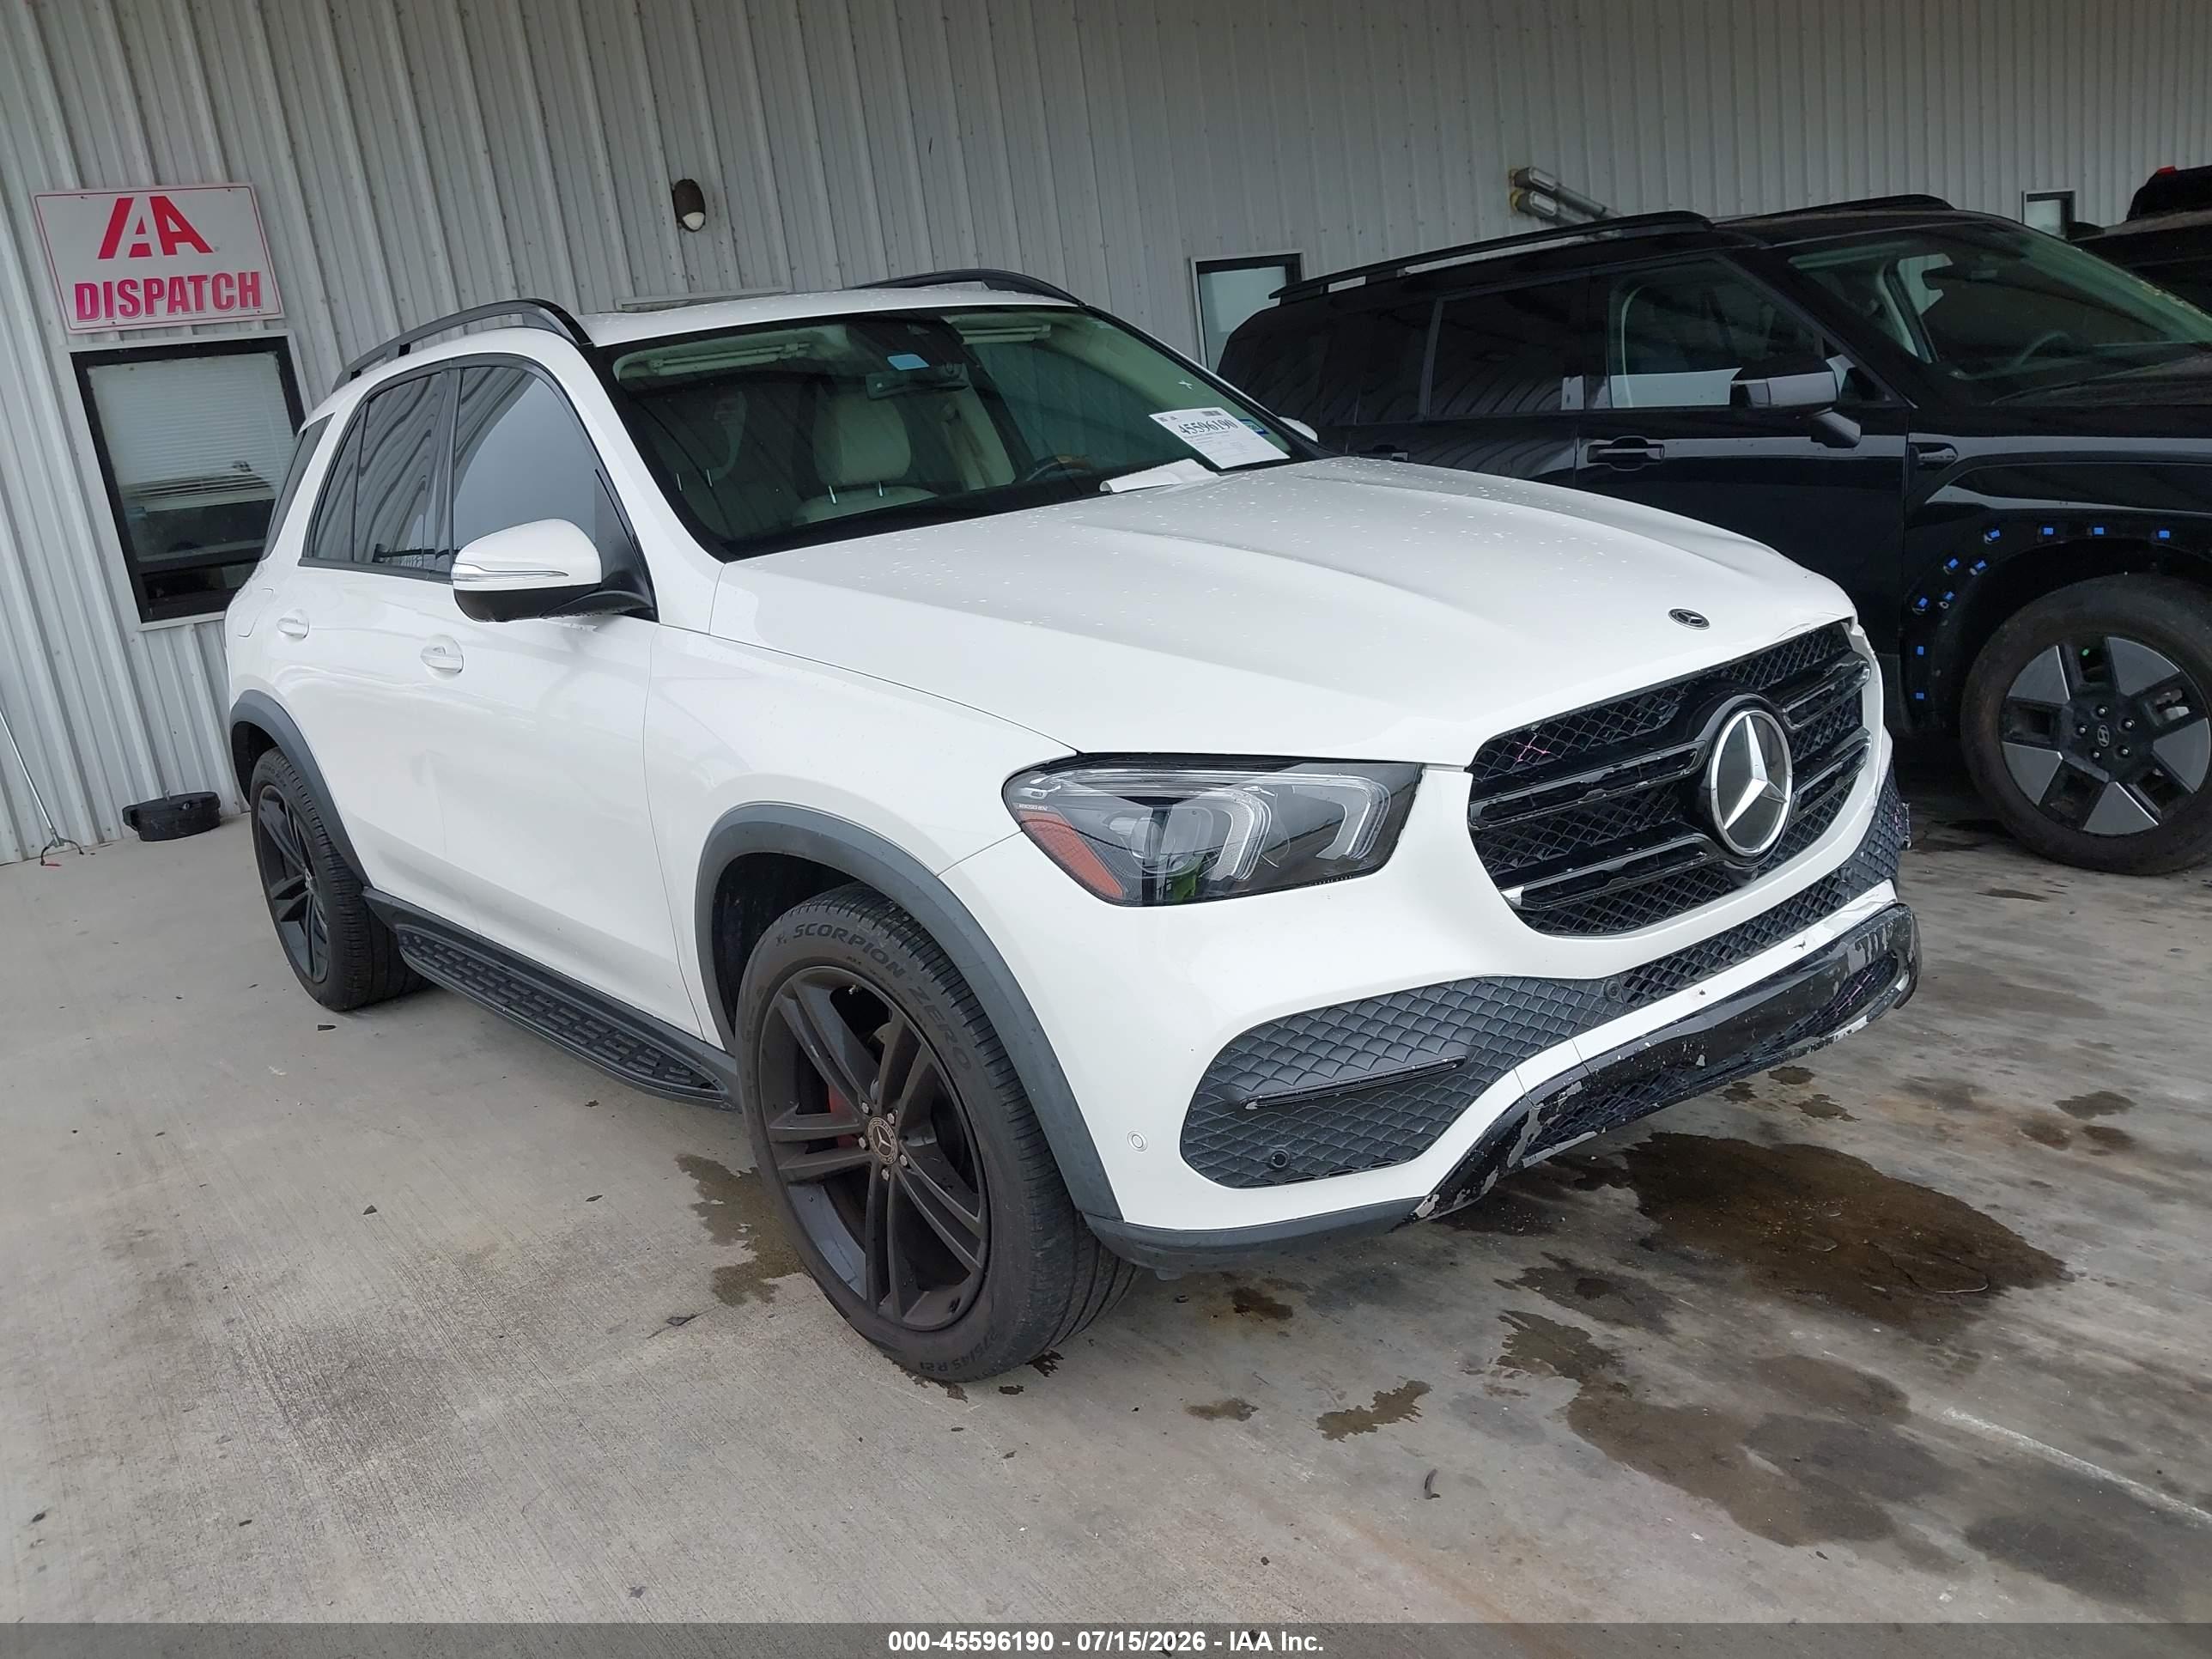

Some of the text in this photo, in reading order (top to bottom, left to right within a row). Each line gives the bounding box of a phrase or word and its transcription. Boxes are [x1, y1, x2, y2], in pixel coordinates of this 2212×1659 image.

[75, 271, 261, 322] DISPATCH
[1178, 419, 1238, 434] 45596190
[793, 922, 906, 979] SCORPION
[908, 986, 972, 1072] ZERO
